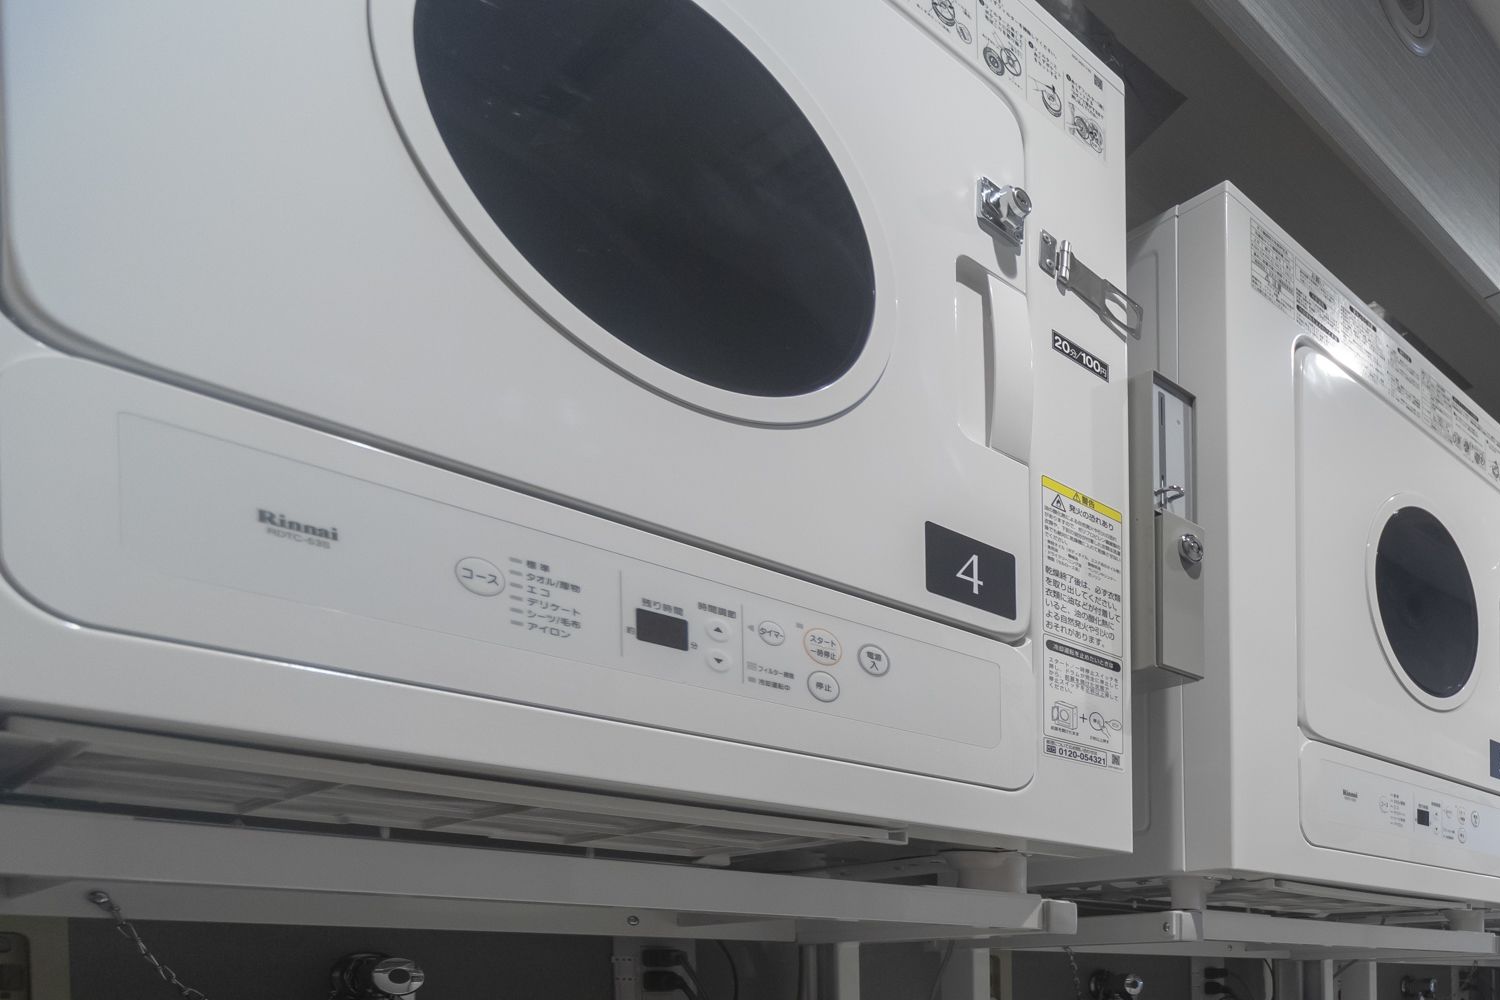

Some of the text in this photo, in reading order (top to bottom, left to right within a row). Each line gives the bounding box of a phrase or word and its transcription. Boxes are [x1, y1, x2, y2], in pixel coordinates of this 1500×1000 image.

[1054, 335, 1107, 378] 20分/100円
[258, 507, 339, 541] Rinnai
[1069, 504, 1114, 531] 発火の恐れあり
[461, 567, 500, 586] コース
[956, 554, 983, 594] 4
[1045, 566, 1121, 602] 乾燥終了後は、必ず衣類
[527, 584, 550, 598] エコ
[1045, 577, 1118, 611] を取り出してください。
[527, 598, 581, 617] デリケート
[1045, 588, 1121, 623] 衣類に油などが付着して
[528, 622, 571, 639] アイロン
[759, 627, 784, 640] タイマー
[1045, 611, 1115, 640] よる自然発火や引火の
[1045, 621, 1105, 648] おそれがあります。
[810, 634, 836, 647] スタート
[816, 682, 832, 693] 停止
[1059, 747, 1106, 765] 0120-054321
